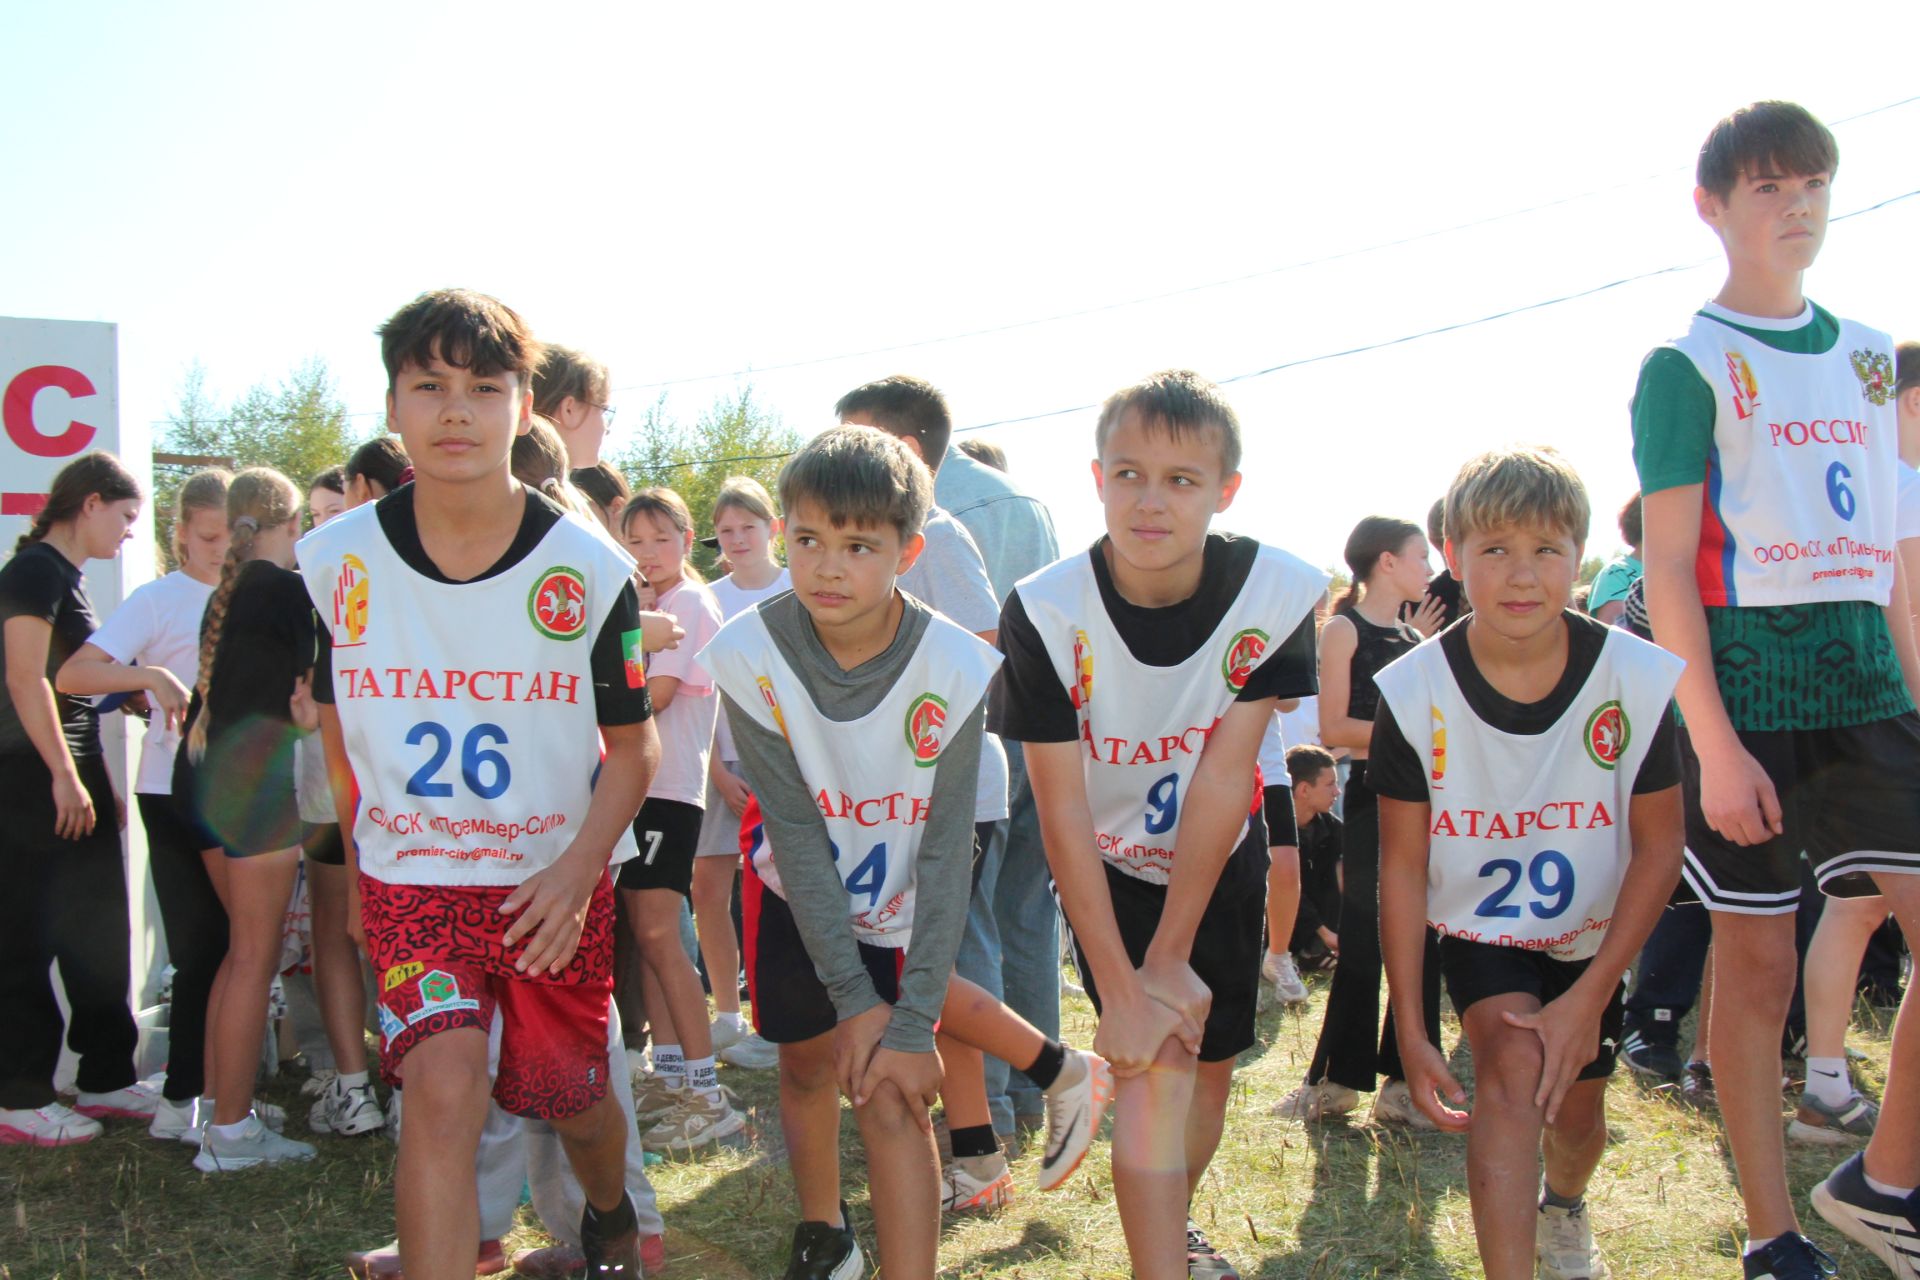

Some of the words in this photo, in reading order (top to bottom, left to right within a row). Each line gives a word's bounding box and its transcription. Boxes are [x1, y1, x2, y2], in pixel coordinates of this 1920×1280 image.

[1826, 461, 1855, 522] 6
[340, 667, 580, 704] ТАТАРСТАН
[405, 721, 511, 799] 26
[1145, 772, 1179, 835] 9
[397, 846, 523, 861] premier-city@mail.ru
[645, 830, 663, 865] 7
[830, 842, 886, 907] 4
[1474, 850, 1575, 919] 29
